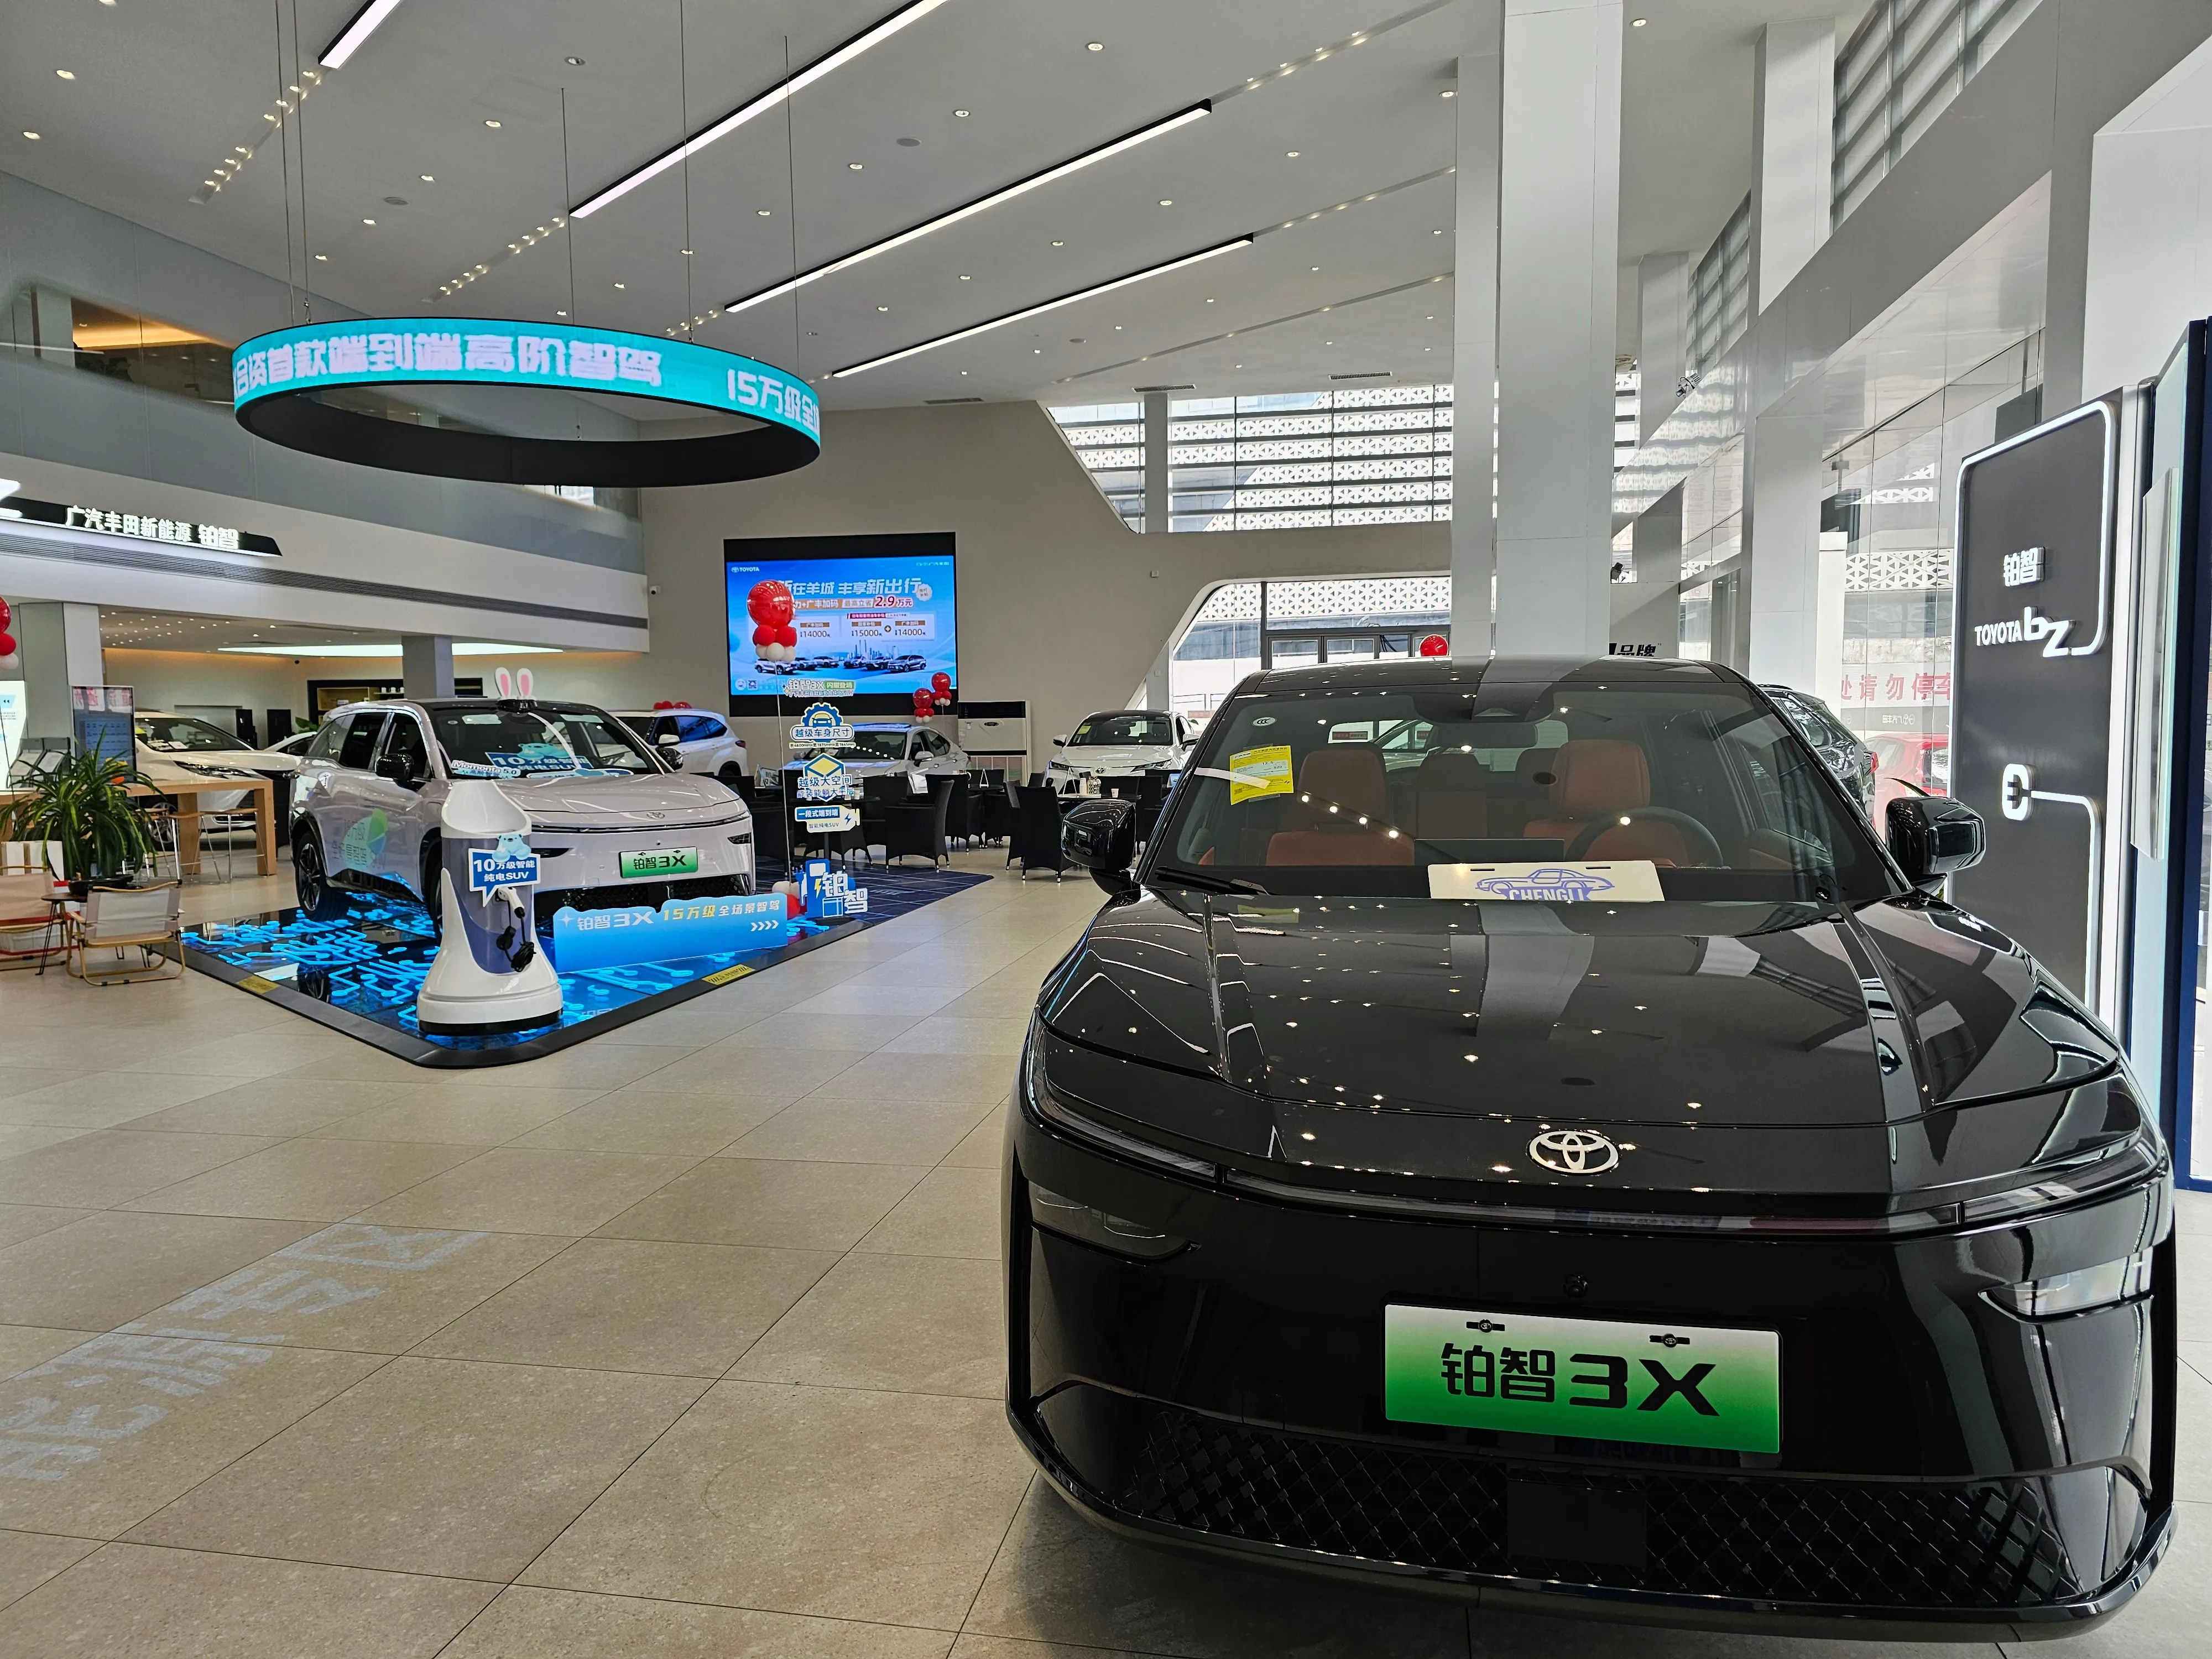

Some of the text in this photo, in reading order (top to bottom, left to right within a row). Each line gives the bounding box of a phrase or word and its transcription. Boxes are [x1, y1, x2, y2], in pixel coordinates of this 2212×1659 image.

[233, 332, 662, 399] 合资首款端到端高阶智驾
[65, 505, 240, 549] 广汽丰田新能源 铂智
[2003, 546, 2042, 587] 铂智
[838, 577, 922, 595] 丰享新出行
[1975, 619, 2022, 646] TOYOTA
[789, 680, 825, 690] 铂智3X
[795, 728, 849, 738] 越级车身尺寸
[799, 774, 852, 787] 越级大空间
[798, 808, 838, 818] 一段式端到端
[473, 858, 535, 872] 10万级智能
[633, 854, 687, 869] 铂智3X
[484, 872, 529, 882] 纯电SUV
[577, 910, 654, 931] 铂智3X
[1440, 1343, 1720, 1417] 铂智3X
